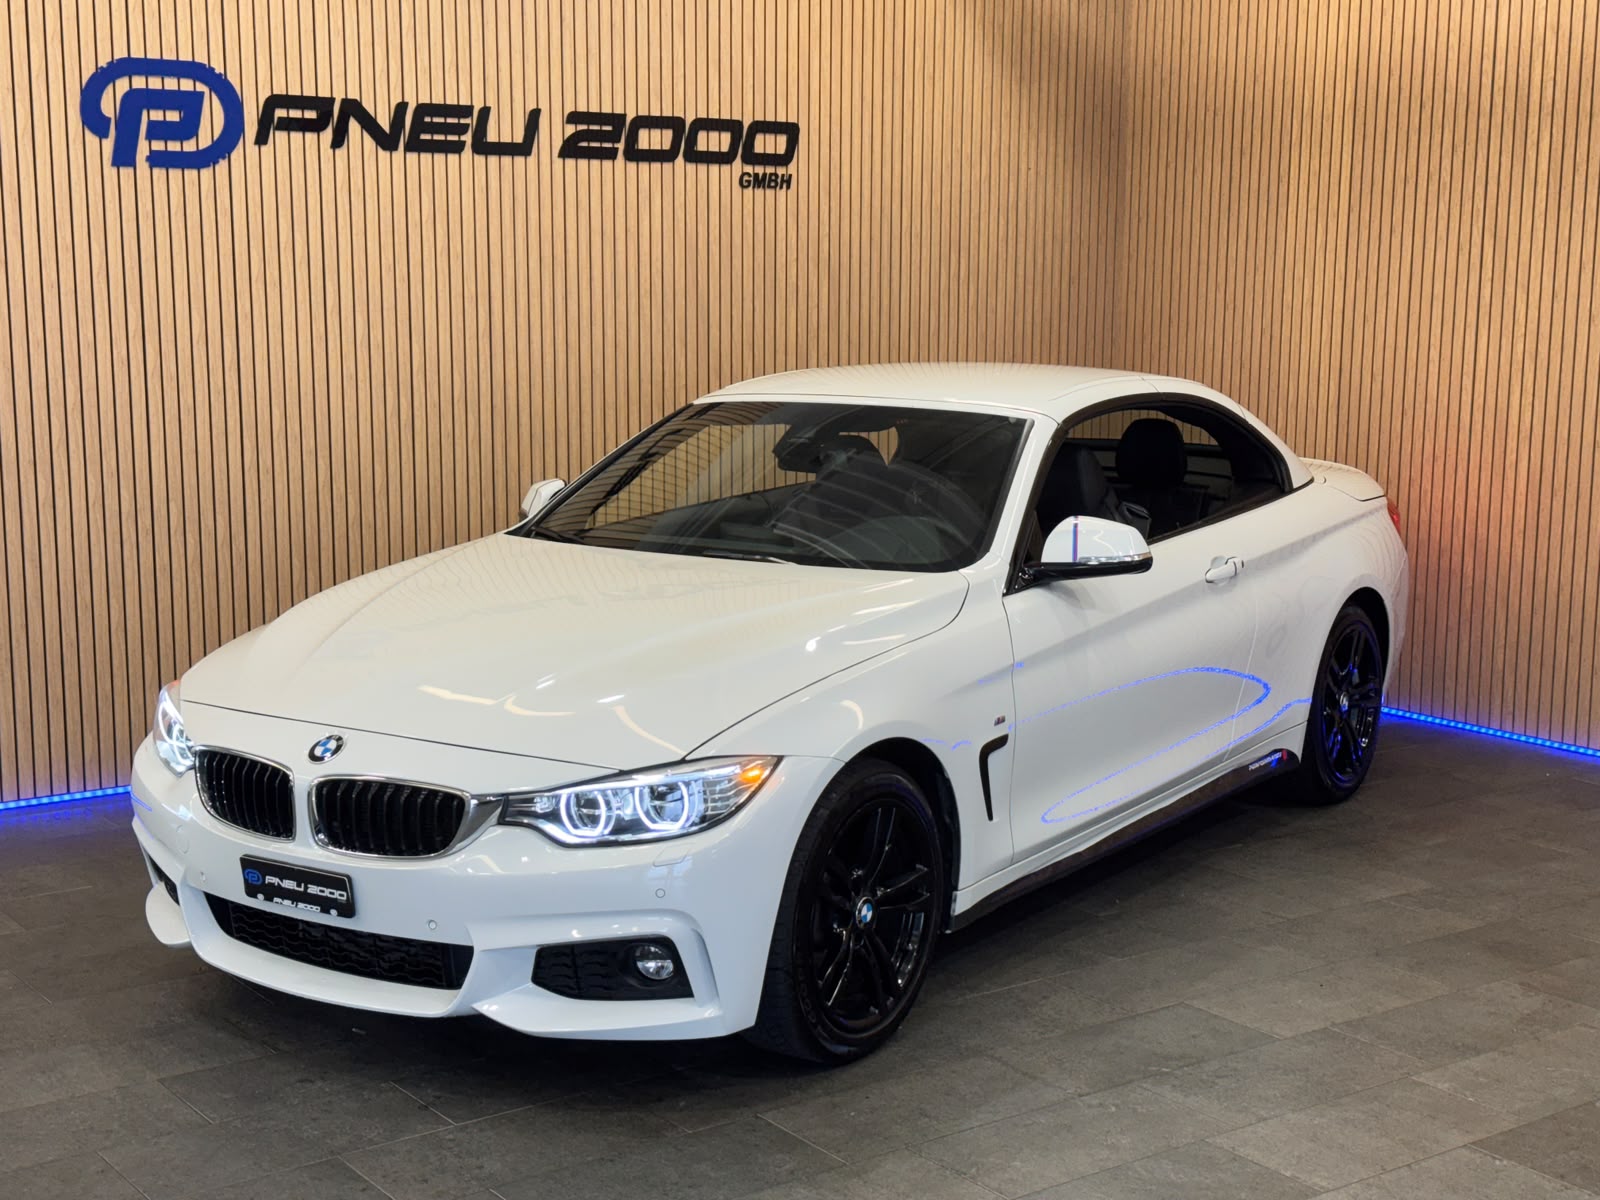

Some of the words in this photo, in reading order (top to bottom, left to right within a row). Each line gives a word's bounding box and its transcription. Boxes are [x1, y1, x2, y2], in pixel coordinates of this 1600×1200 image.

[254, 93, 541, 157] PNEU
[557, 111, 800, 166] 2000
[738, 171, 793, 190] GMBH
[265, 875, 305, 892] PNEU
[307, 884, 347, 901] 2000
[273, 897, 297, 907] PNEU
[297, 902, 321, 913] 2000
